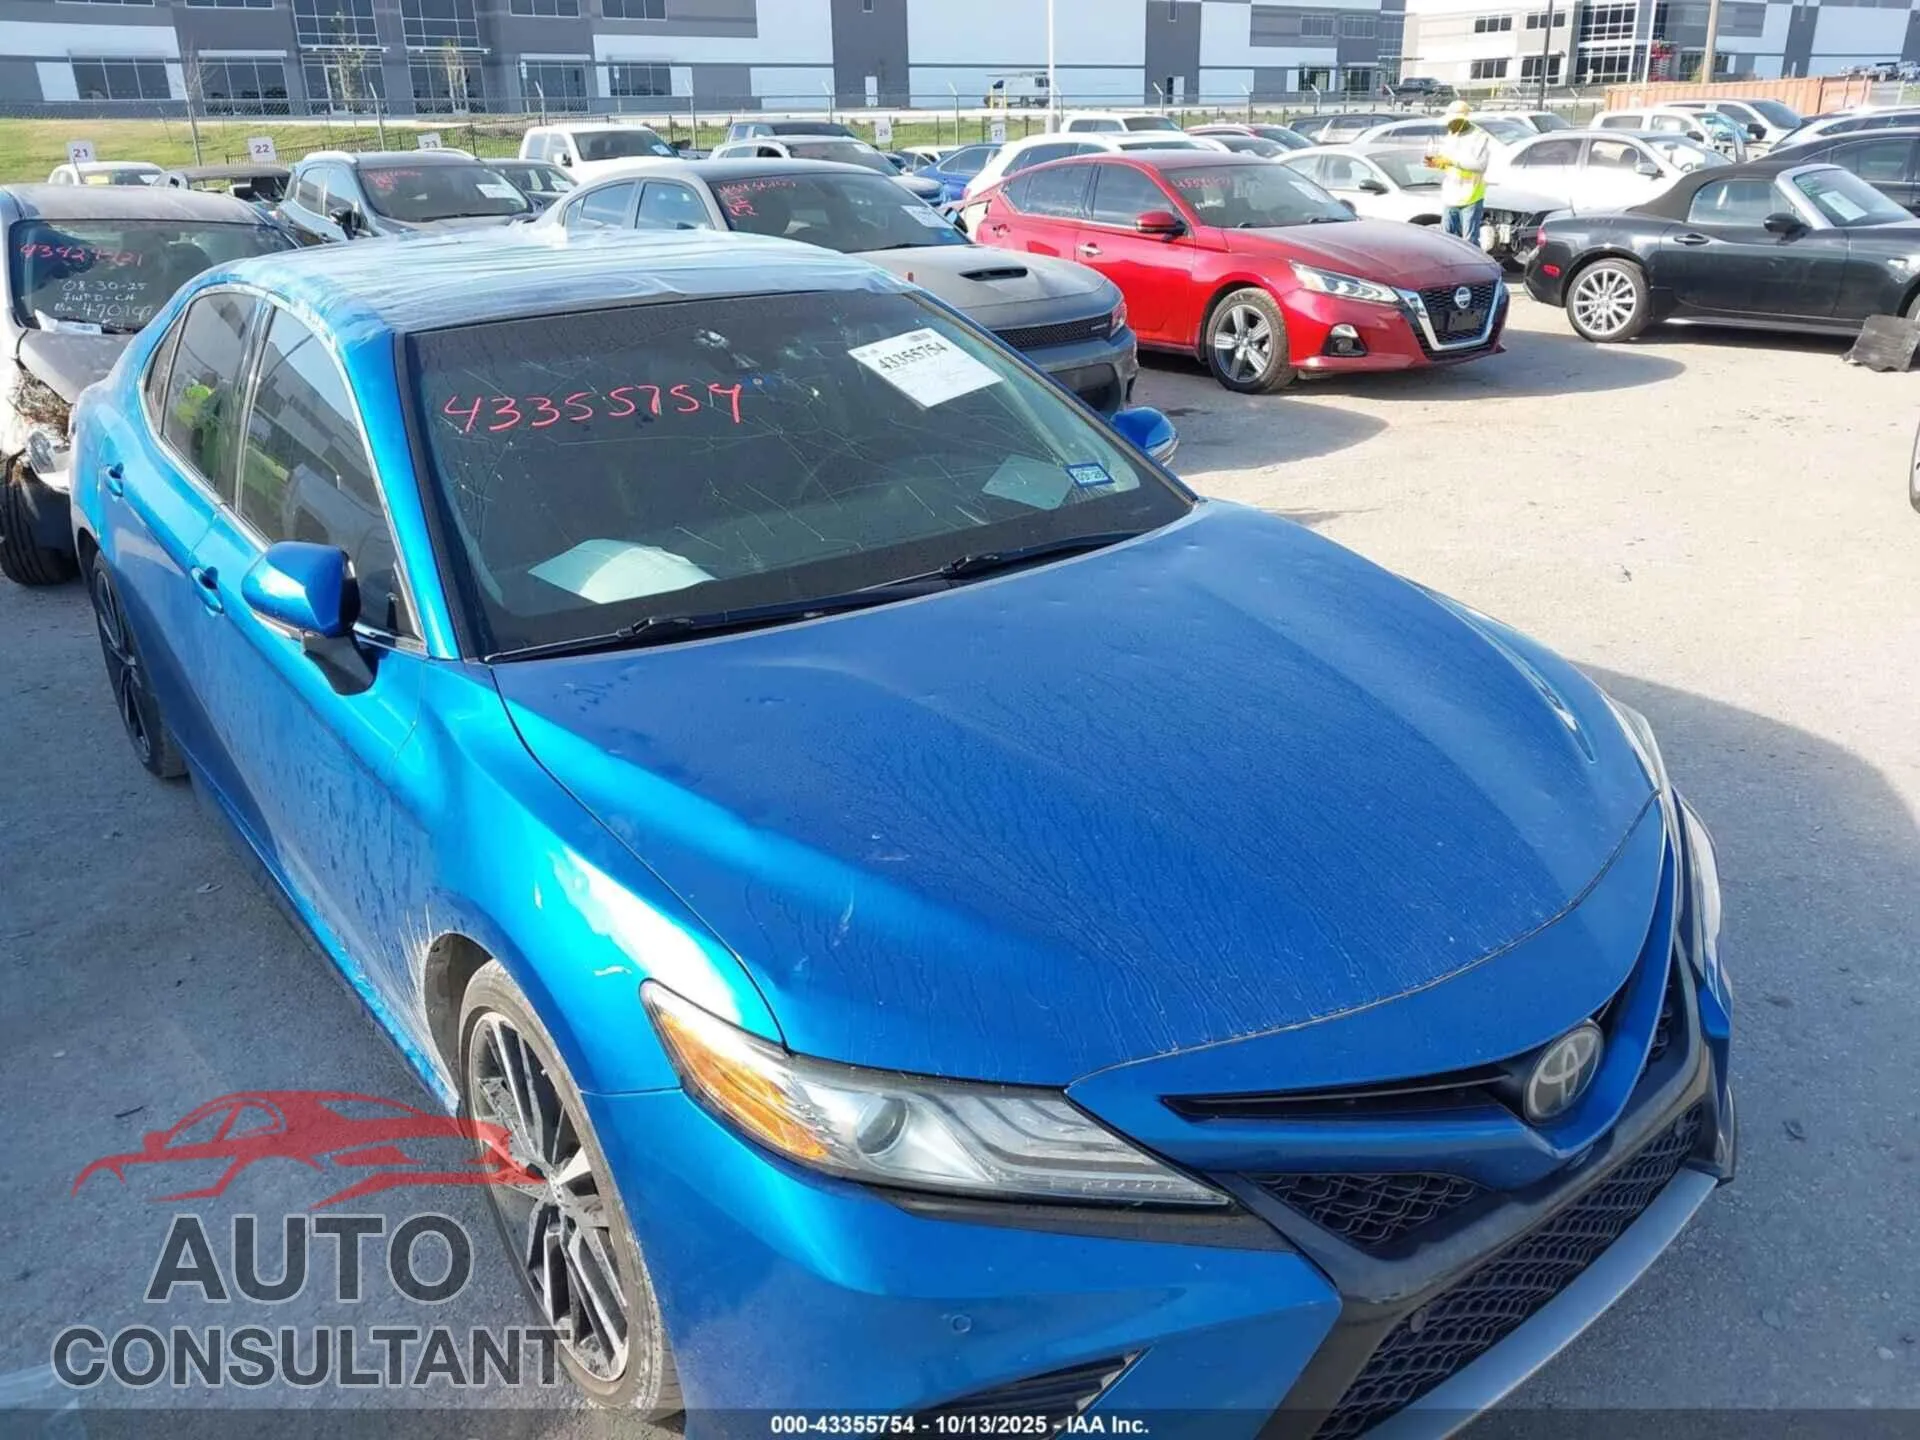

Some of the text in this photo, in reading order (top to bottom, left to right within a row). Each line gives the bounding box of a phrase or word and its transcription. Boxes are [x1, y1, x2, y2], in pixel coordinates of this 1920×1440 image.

[73, 148, 88, 158] 21
[255, 144, 270, 154] 22
[877, 341, 948, 371] 43355754
[444, 384, 742, 433] 43355754
